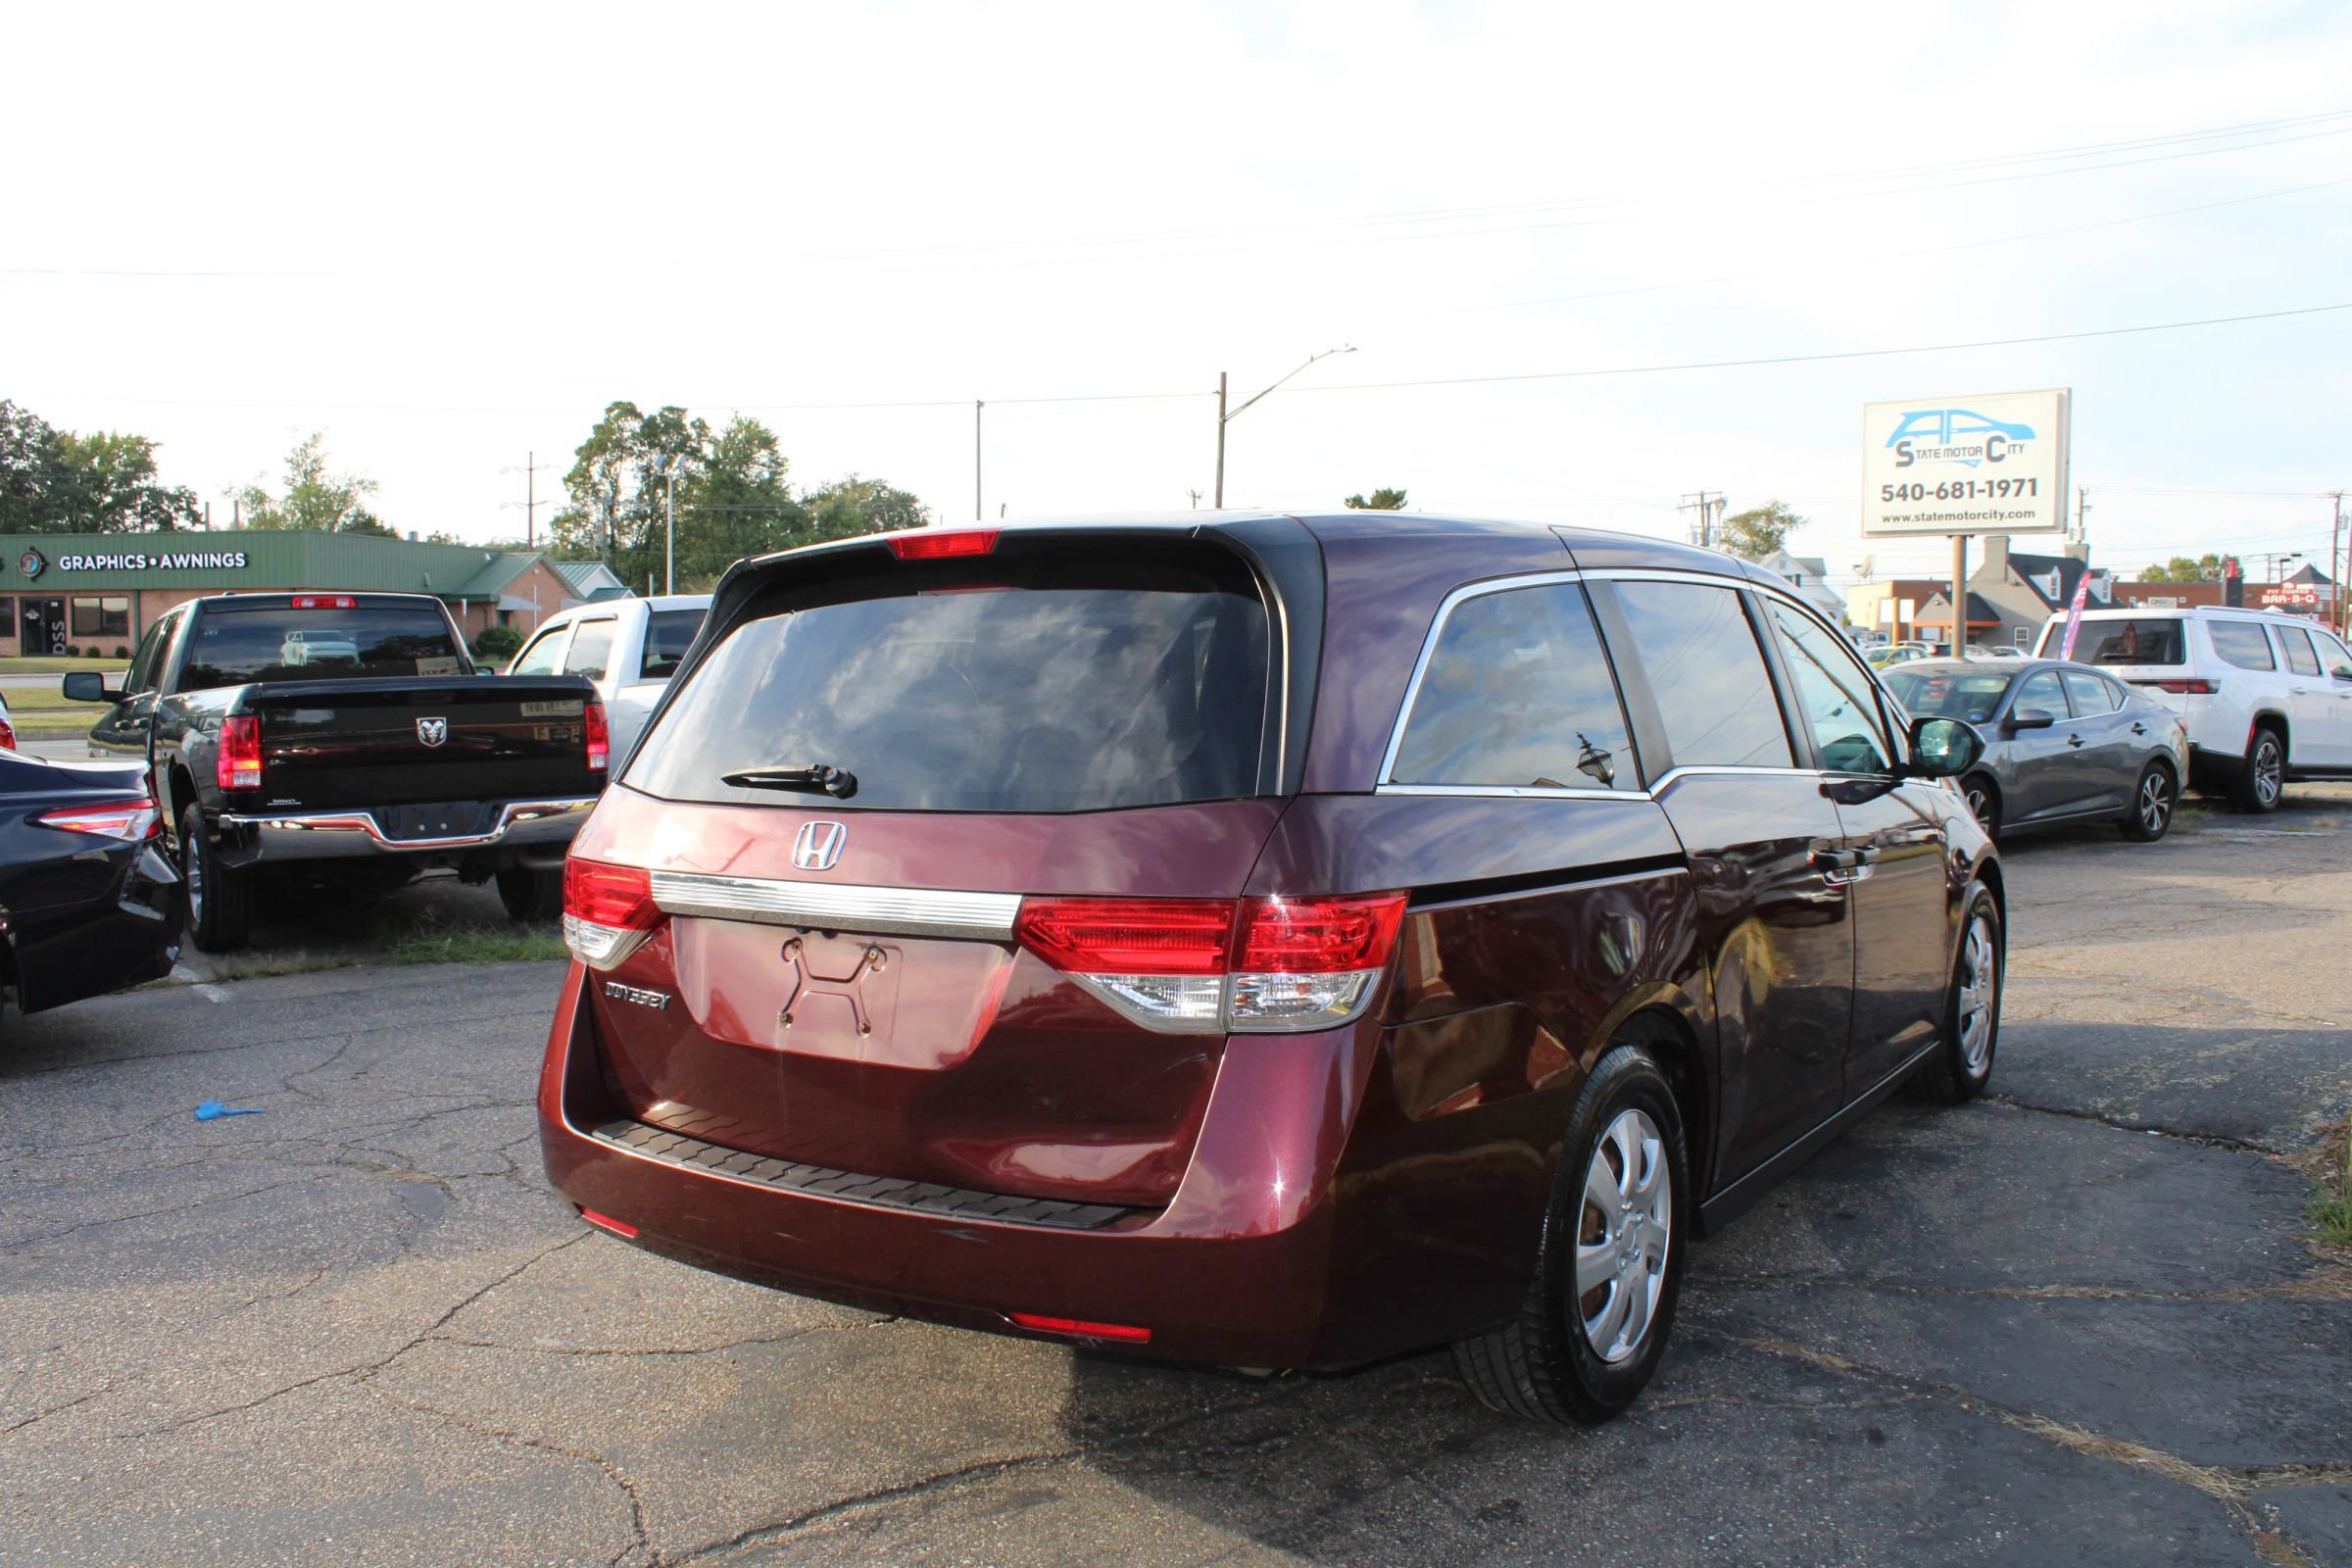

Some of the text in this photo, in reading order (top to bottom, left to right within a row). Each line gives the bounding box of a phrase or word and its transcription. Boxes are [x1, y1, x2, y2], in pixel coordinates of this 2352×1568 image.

[1895, 435, 2025, 467] STATE MOTOR CITY
[1881, 477, 2037, 502] 540-681-1971
[1882, 509, 2035, 523] www.statemotorcity.com
[59, 552, 246, 571] GRAPHICS AWNINGS
[2261, 594, 2315, 604] BAR-B-Q
[51, 620, 66, 655] DSS
[605, 981, 673, 1010] ODYSSEY
